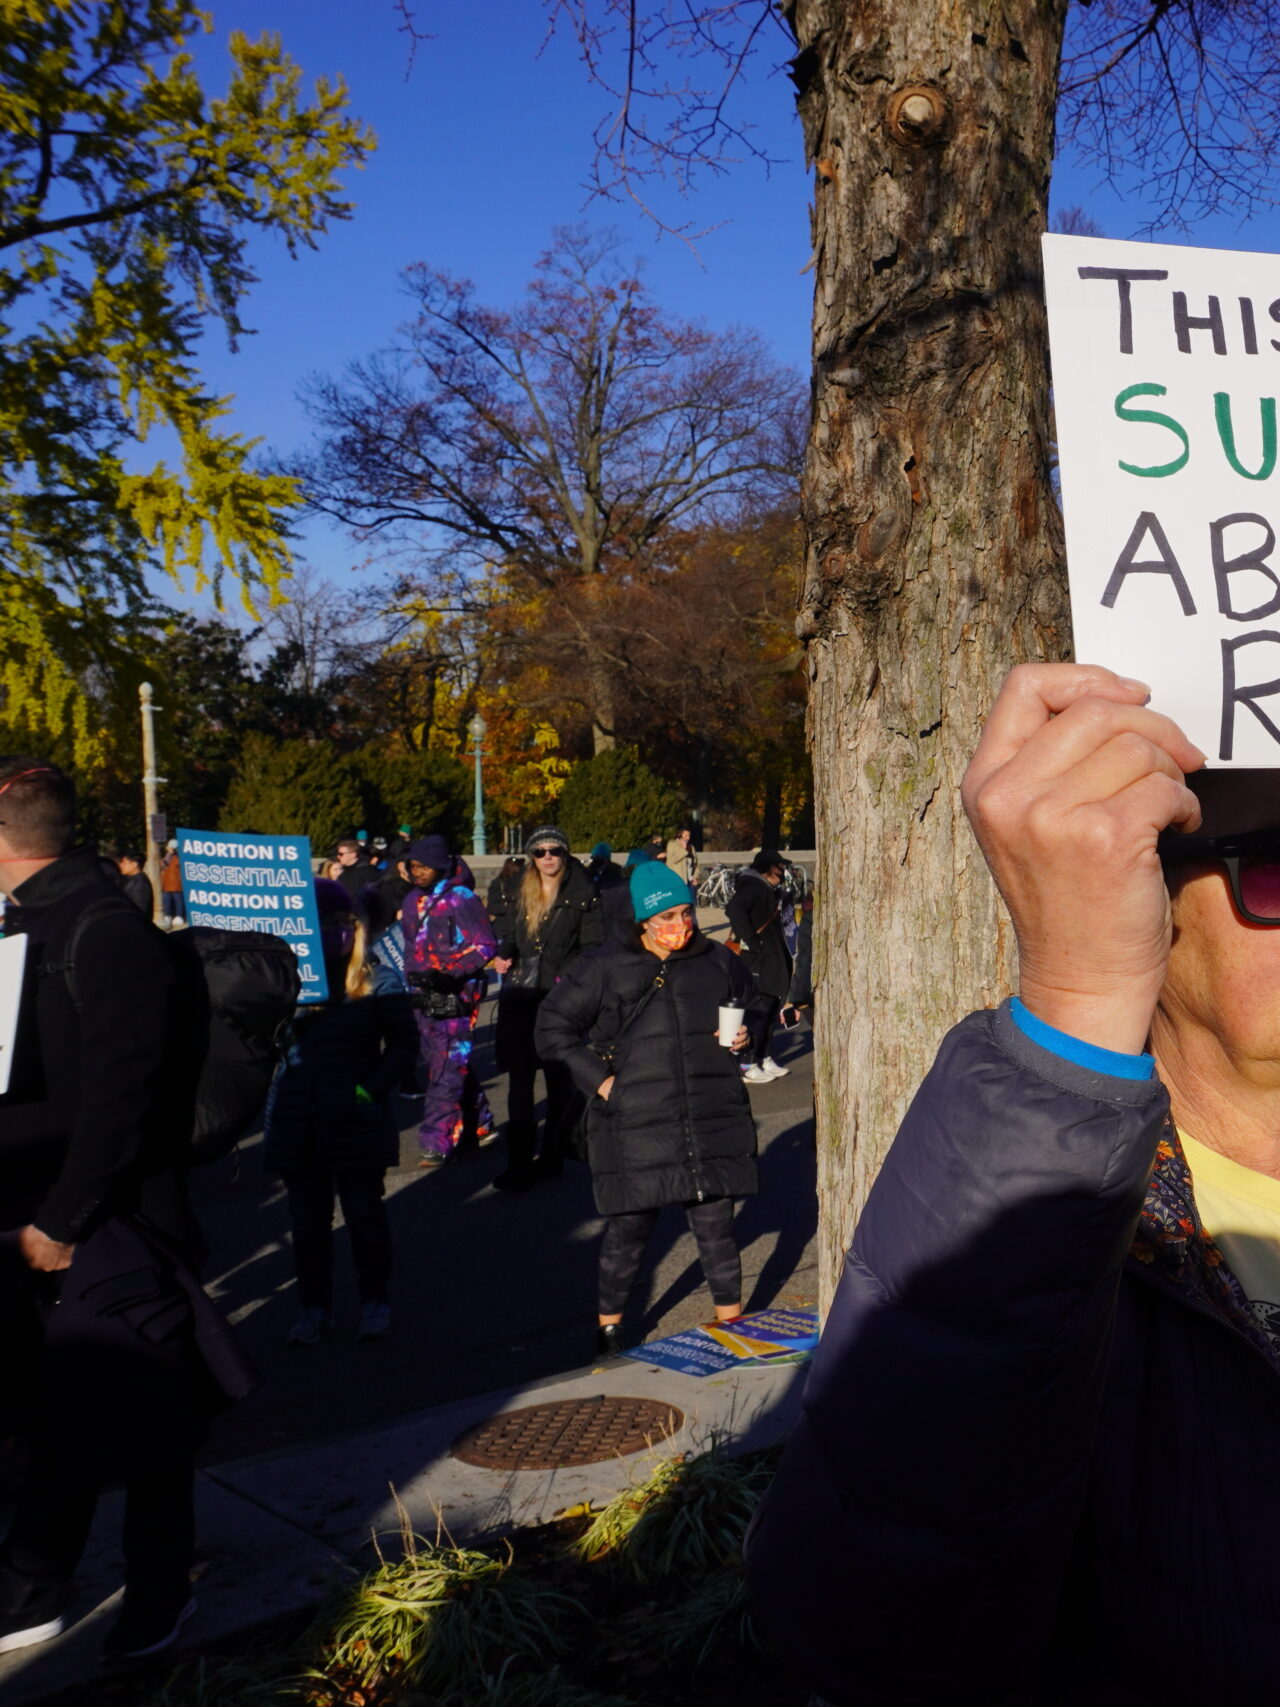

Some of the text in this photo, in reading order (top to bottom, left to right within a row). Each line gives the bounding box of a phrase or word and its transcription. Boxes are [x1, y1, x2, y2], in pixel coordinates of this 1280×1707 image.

[183, 839, 299, 861] ABORTION IS
[184, 861, 308, 888] ESSENTIAL
[188, 889, 304, 910] ABORTION IS
[190, 910, 313, 936] ESSENTIAL
